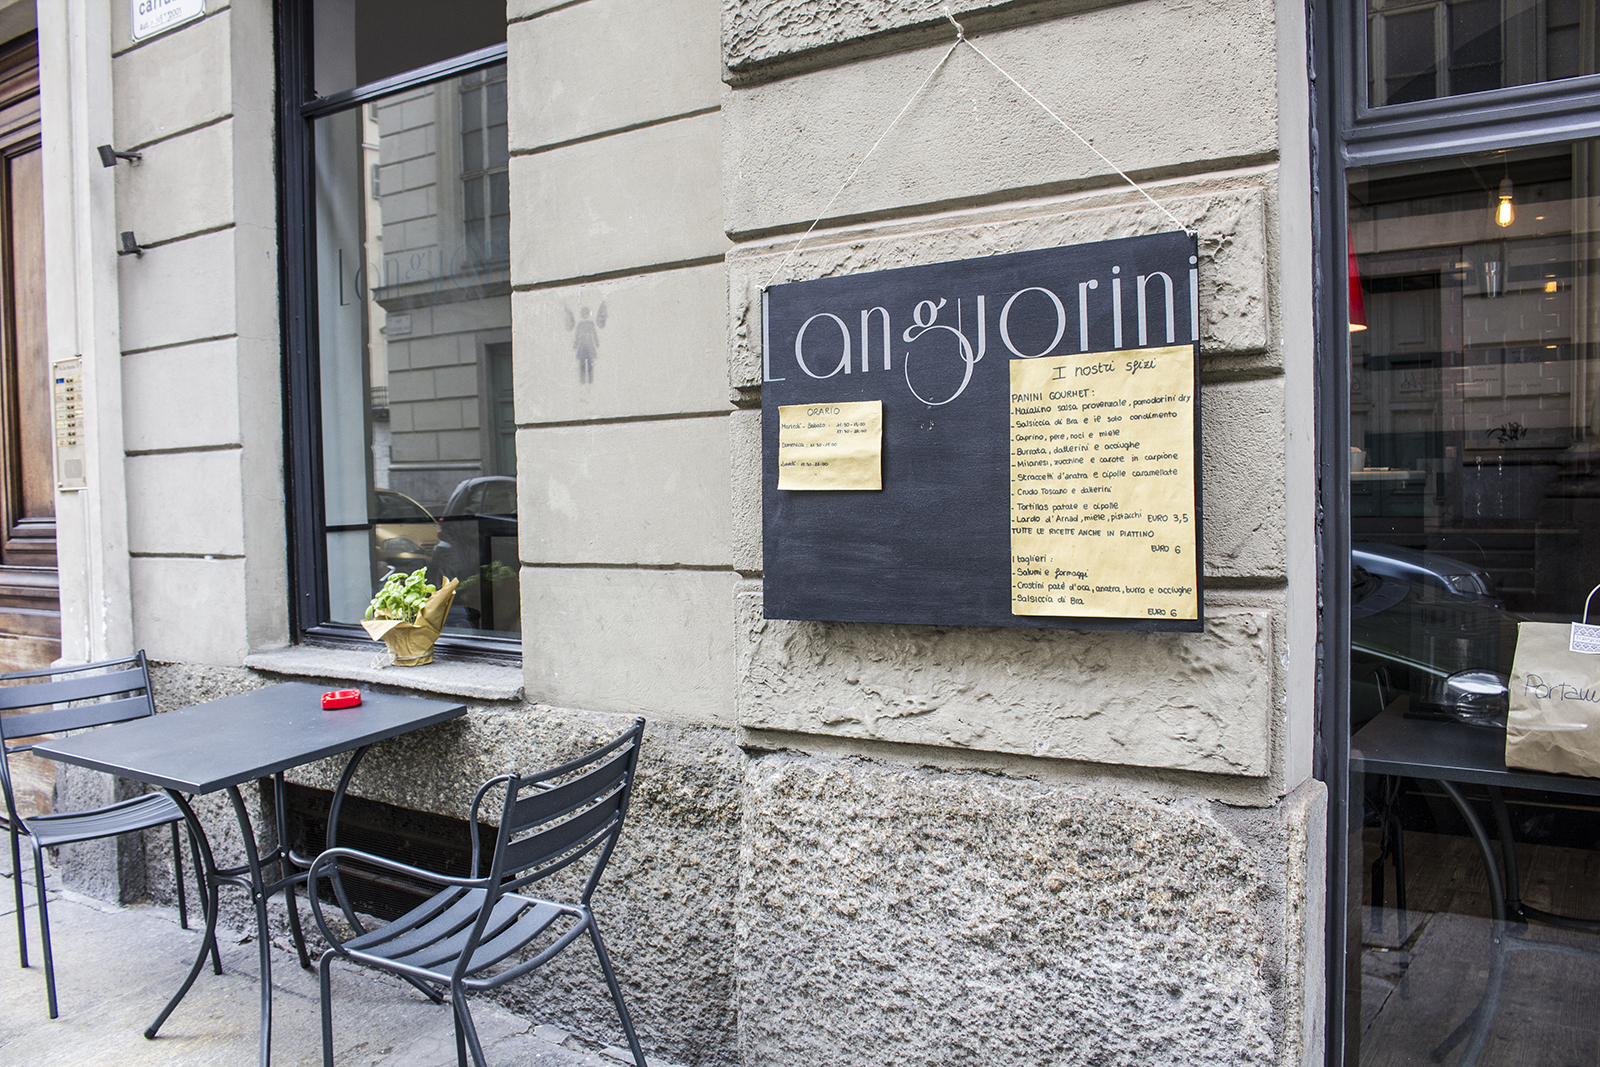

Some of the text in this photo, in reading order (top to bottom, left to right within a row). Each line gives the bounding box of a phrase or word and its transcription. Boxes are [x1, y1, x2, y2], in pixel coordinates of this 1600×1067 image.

[762, 255, 1199, 406] Languorini
[1052, 358, 1156, 380] I nostri sfizi
[1012, 392, 1042, 403] PANINI
[1015, 406, 1051, 415] Maialino
[1178, 393, 1191, 403] dry
[807, 406, 840, 416] ORARIO
[1016, 419, 1050, 428] Salsiccia
[1130, 411, 1177, 420] condimento
[1099, 429, 1120, 437] miele
[1054, 443, 1089, 454] datterini
[1132, 454, 1138, 462] in
[1144, 452, 1178, 461] carpione
[1102, 470, 1126, 480] cipolle
[1132, 468, 1178, 477] caramellate
[1017, 502, 1048, 511] Tortillas
[1052, 503, 1078, 513] patate
[1093, 502, 1119, 510] cipolle
[1111, 509, 1142, 522] pistacchi
[1147, 514, 1168, 522] EURO
[1173, 513, 1189, 524] 3,5
[1174, 545, 1181, 554] 6
[1017, 567, 1042, 576] Salumi
[1055, 568, 1089, 580] formaggi
[1125, 586, 1145, 594] burro
[1158, 586, 1192, 596] acciughe
[1017, 594, 1053, 603] Salsiccia
[1070, 597, 1084, 605] Bra
[1170, 609, 1177, 617] 6
